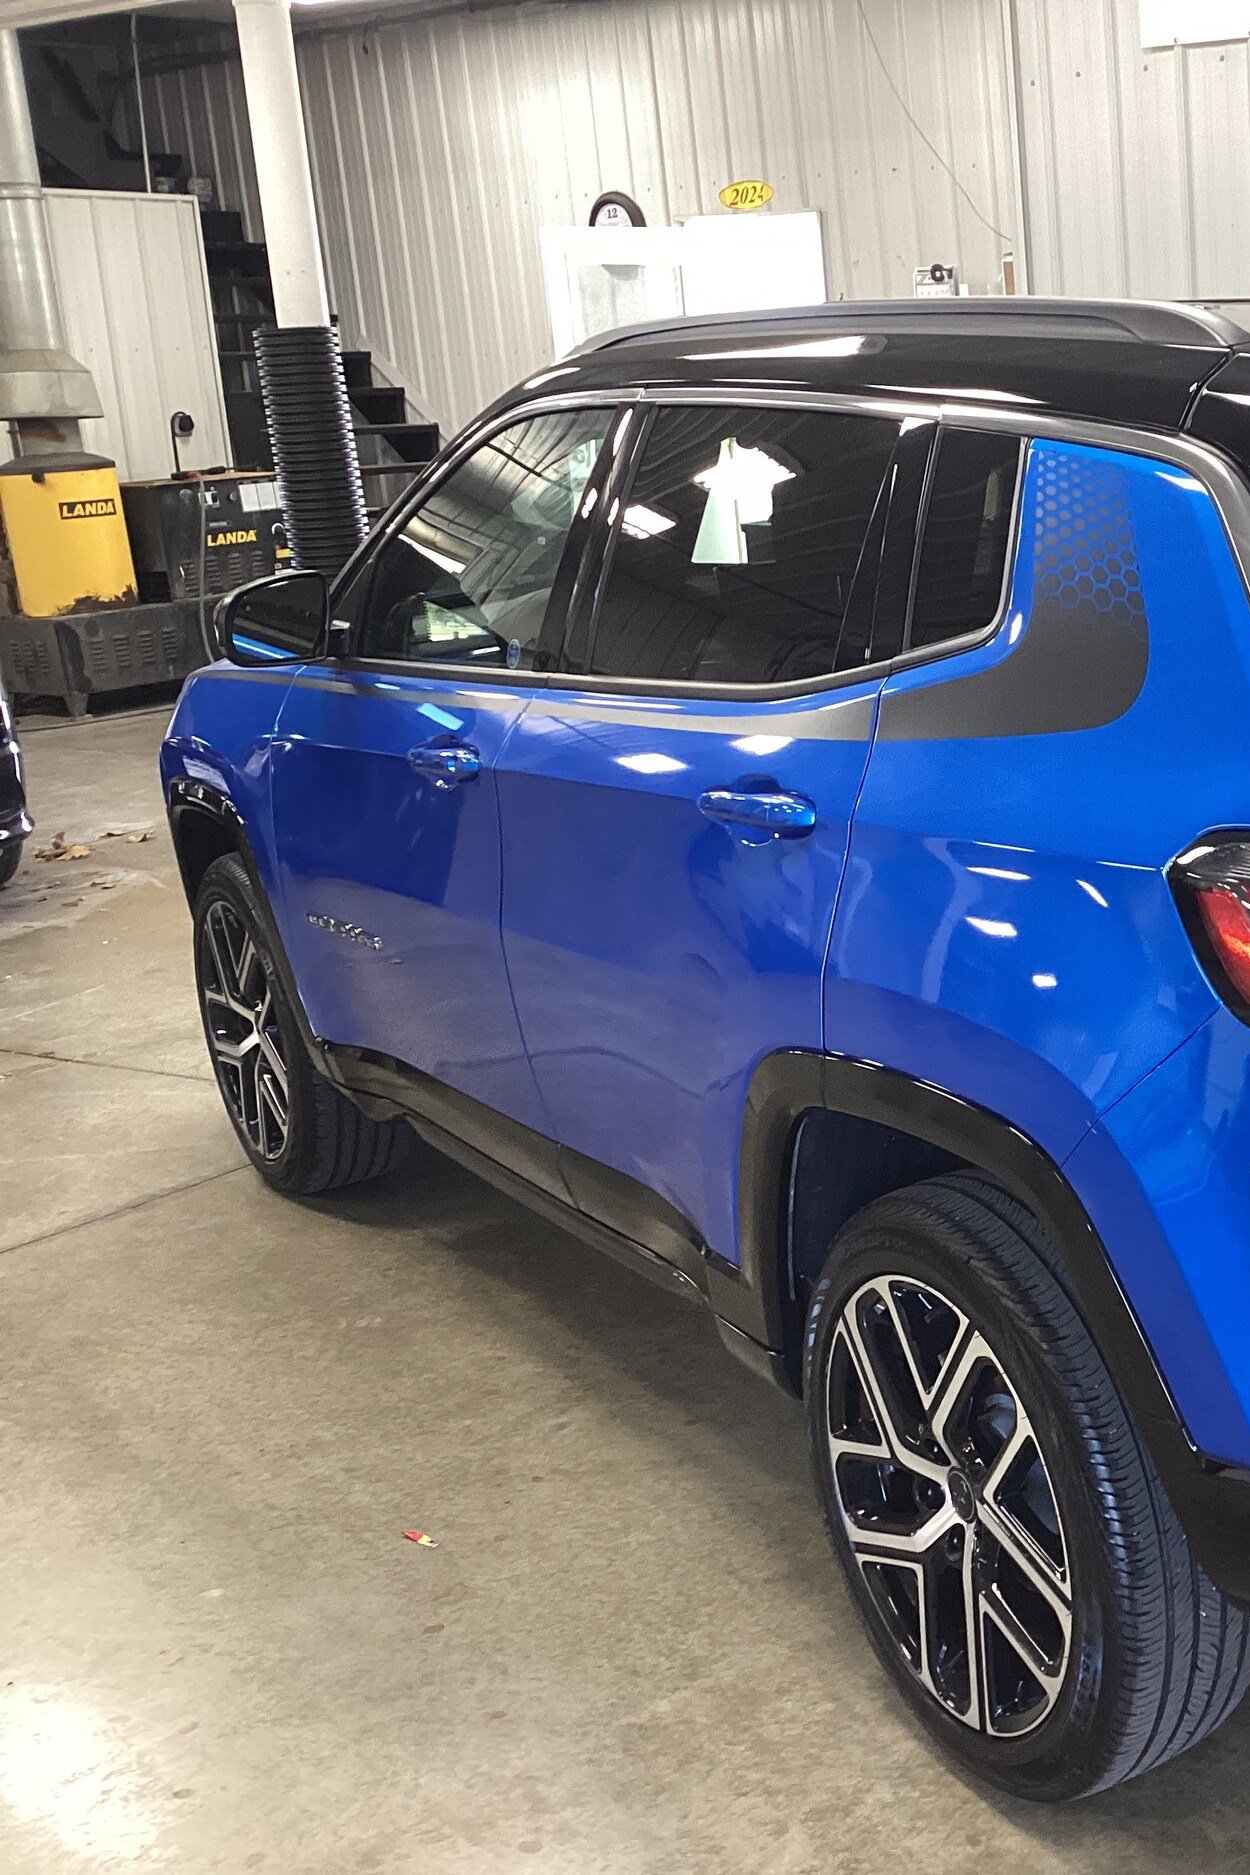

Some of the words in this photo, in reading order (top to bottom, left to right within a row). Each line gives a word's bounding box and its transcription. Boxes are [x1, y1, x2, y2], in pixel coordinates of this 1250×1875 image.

[729, 184, 765, 206] 2024
[607, 207, 618, 219] 12
[62, 500, 115, 517] LANDA
[207, 530, 257, 546] LANDA
